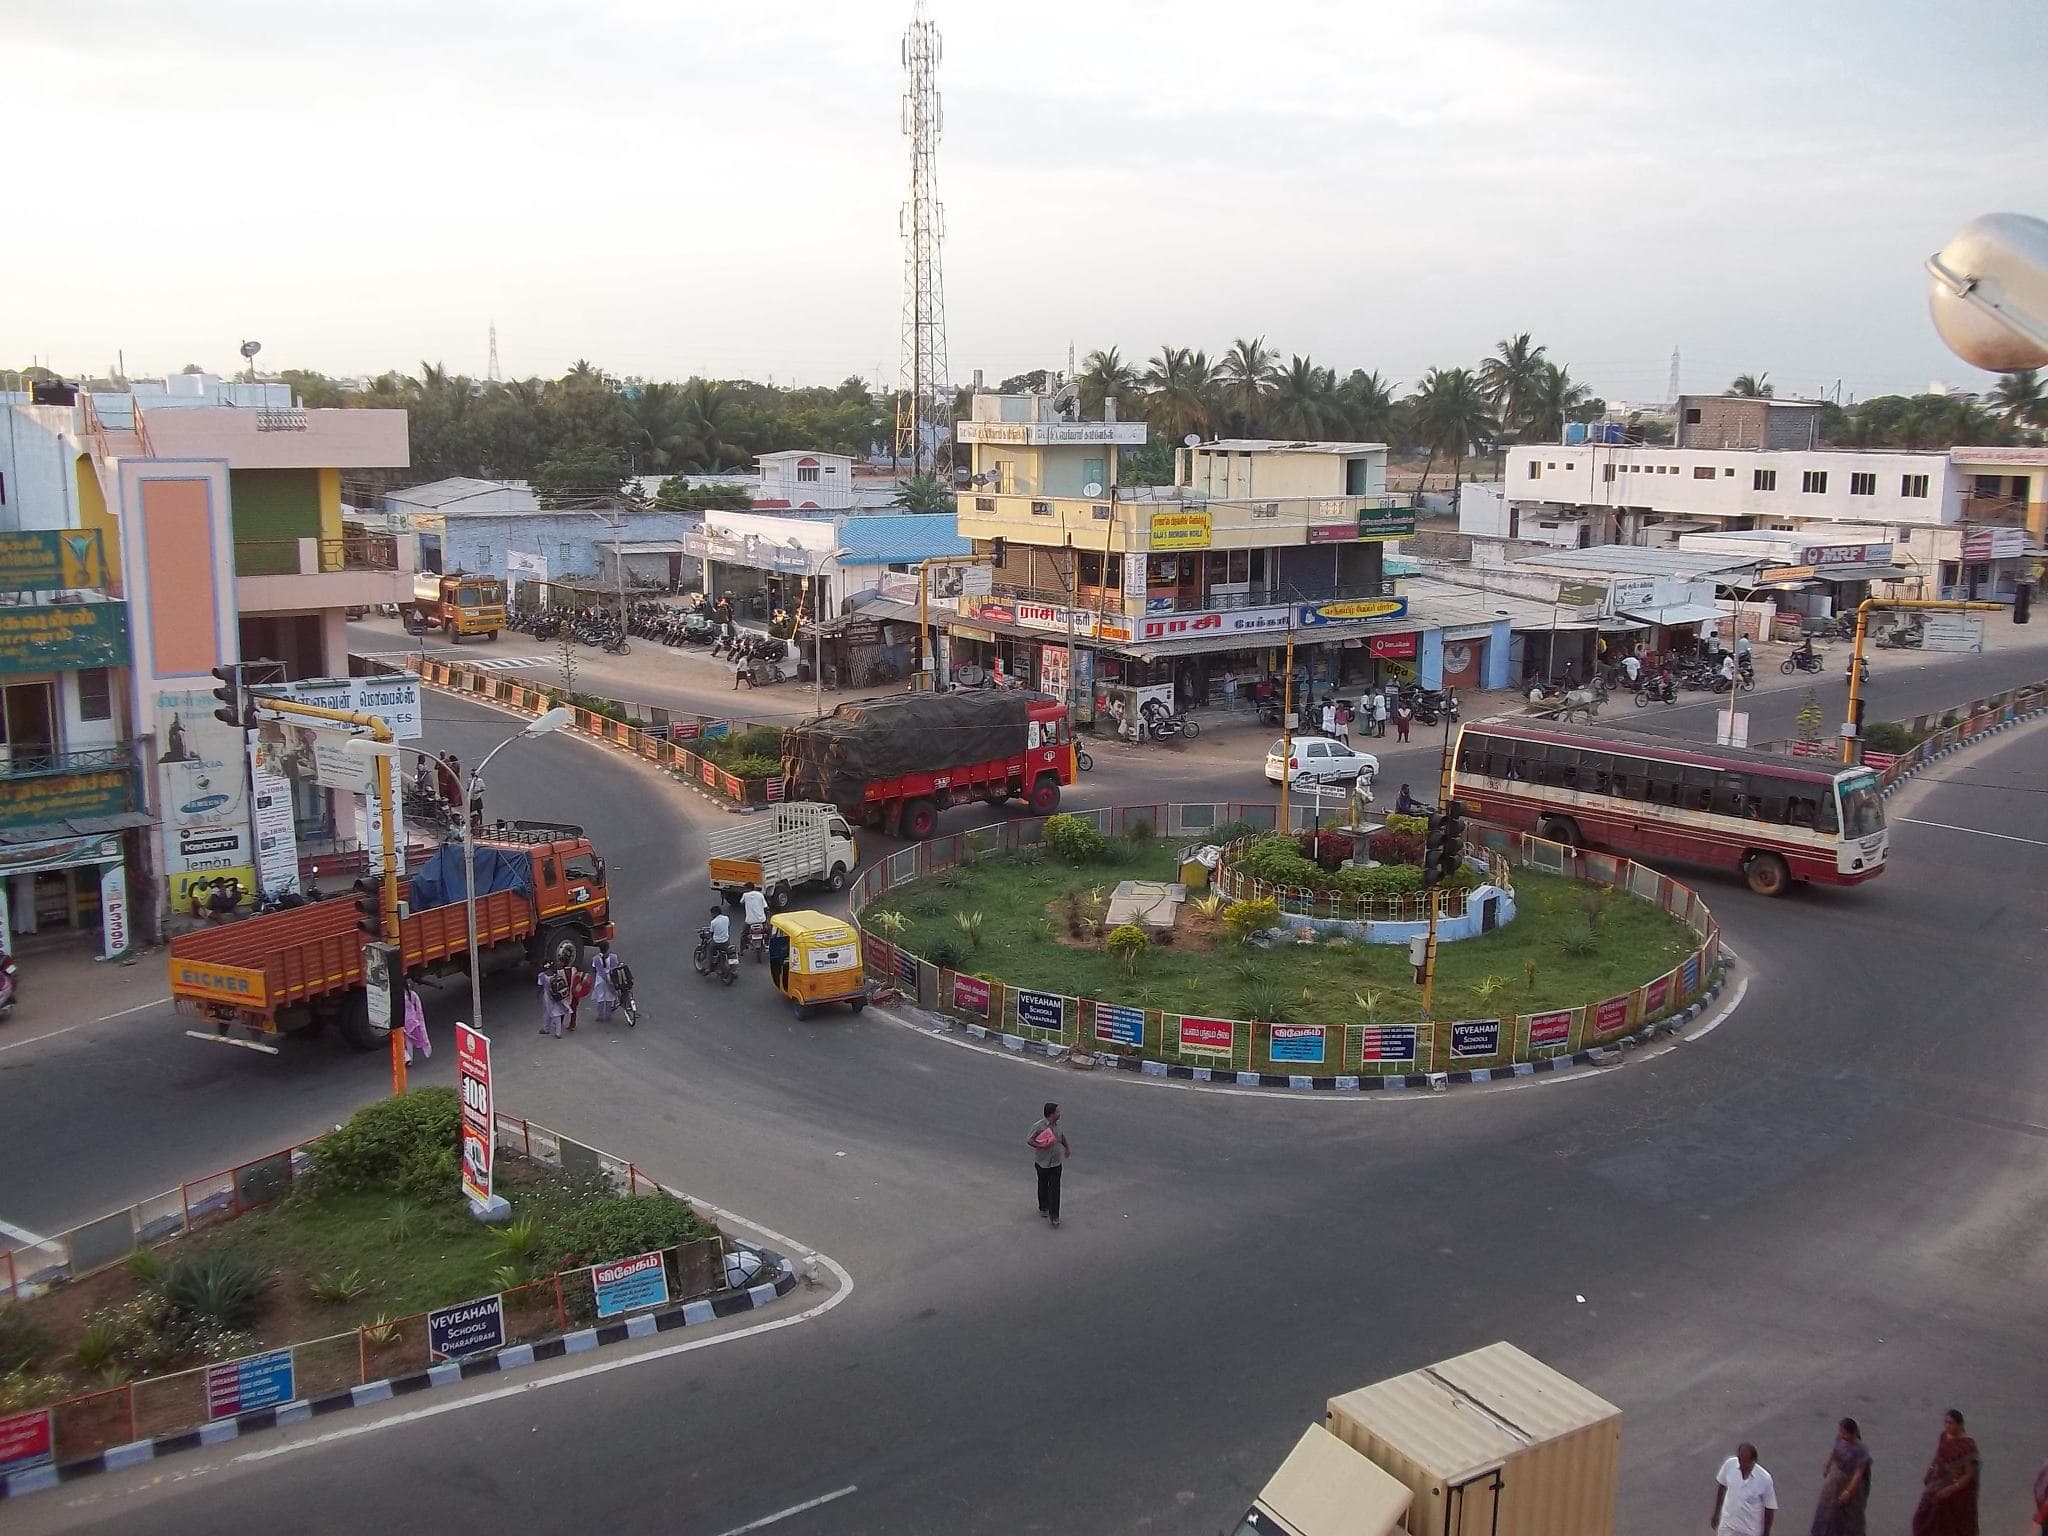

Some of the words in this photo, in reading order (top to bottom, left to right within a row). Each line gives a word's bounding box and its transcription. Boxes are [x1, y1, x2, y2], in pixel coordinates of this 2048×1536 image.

[1823, 546, 1861, 561] MRF
[1019, 606, 1055, 622] ராசி
[1145, 614, 1222, 638] ராசி
[182, 760, 224, 770] NOKIA
[194, 827, 233, 836] MOTOROLA
[184, 839, 236, 852] Karbonn
[182, 968, 249, 993] EICHER
[1020, 994, 1061, 1009] VEVEAHAM
[1274, 1026, 1321, 1038] விவேகம்
[1454, 1024, 1498, 1035] VEVEAHAM
[463, 1076, 487, 1115] 108
[598, 1255, 658, 1282] விவேகம்
[431, 1301, 499, 1330] VEVEAHAM
